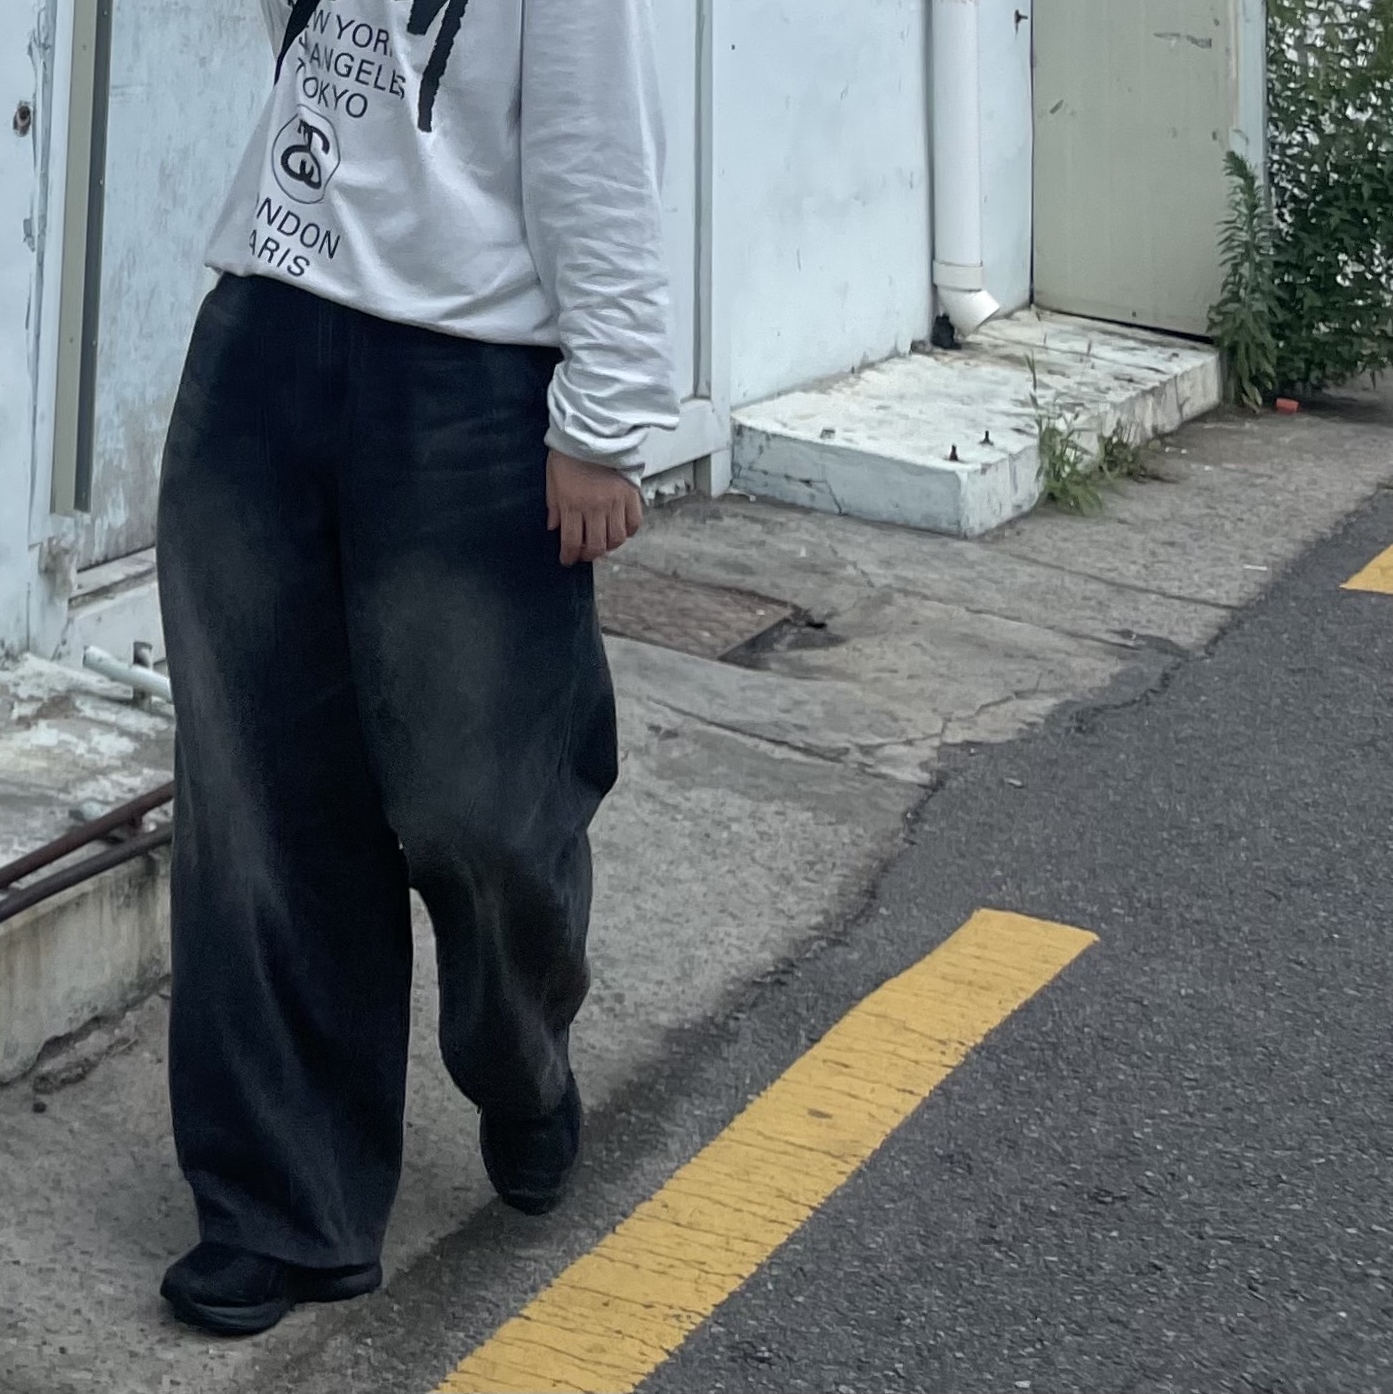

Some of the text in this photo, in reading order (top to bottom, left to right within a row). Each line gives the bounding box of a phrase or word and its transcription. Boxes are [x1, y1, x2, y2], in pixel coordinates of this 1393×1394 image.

[336, 13, 393, 57] YOR
[256, 197, 341, 260] NDON
[249, 229, 311, 277] ARIS
